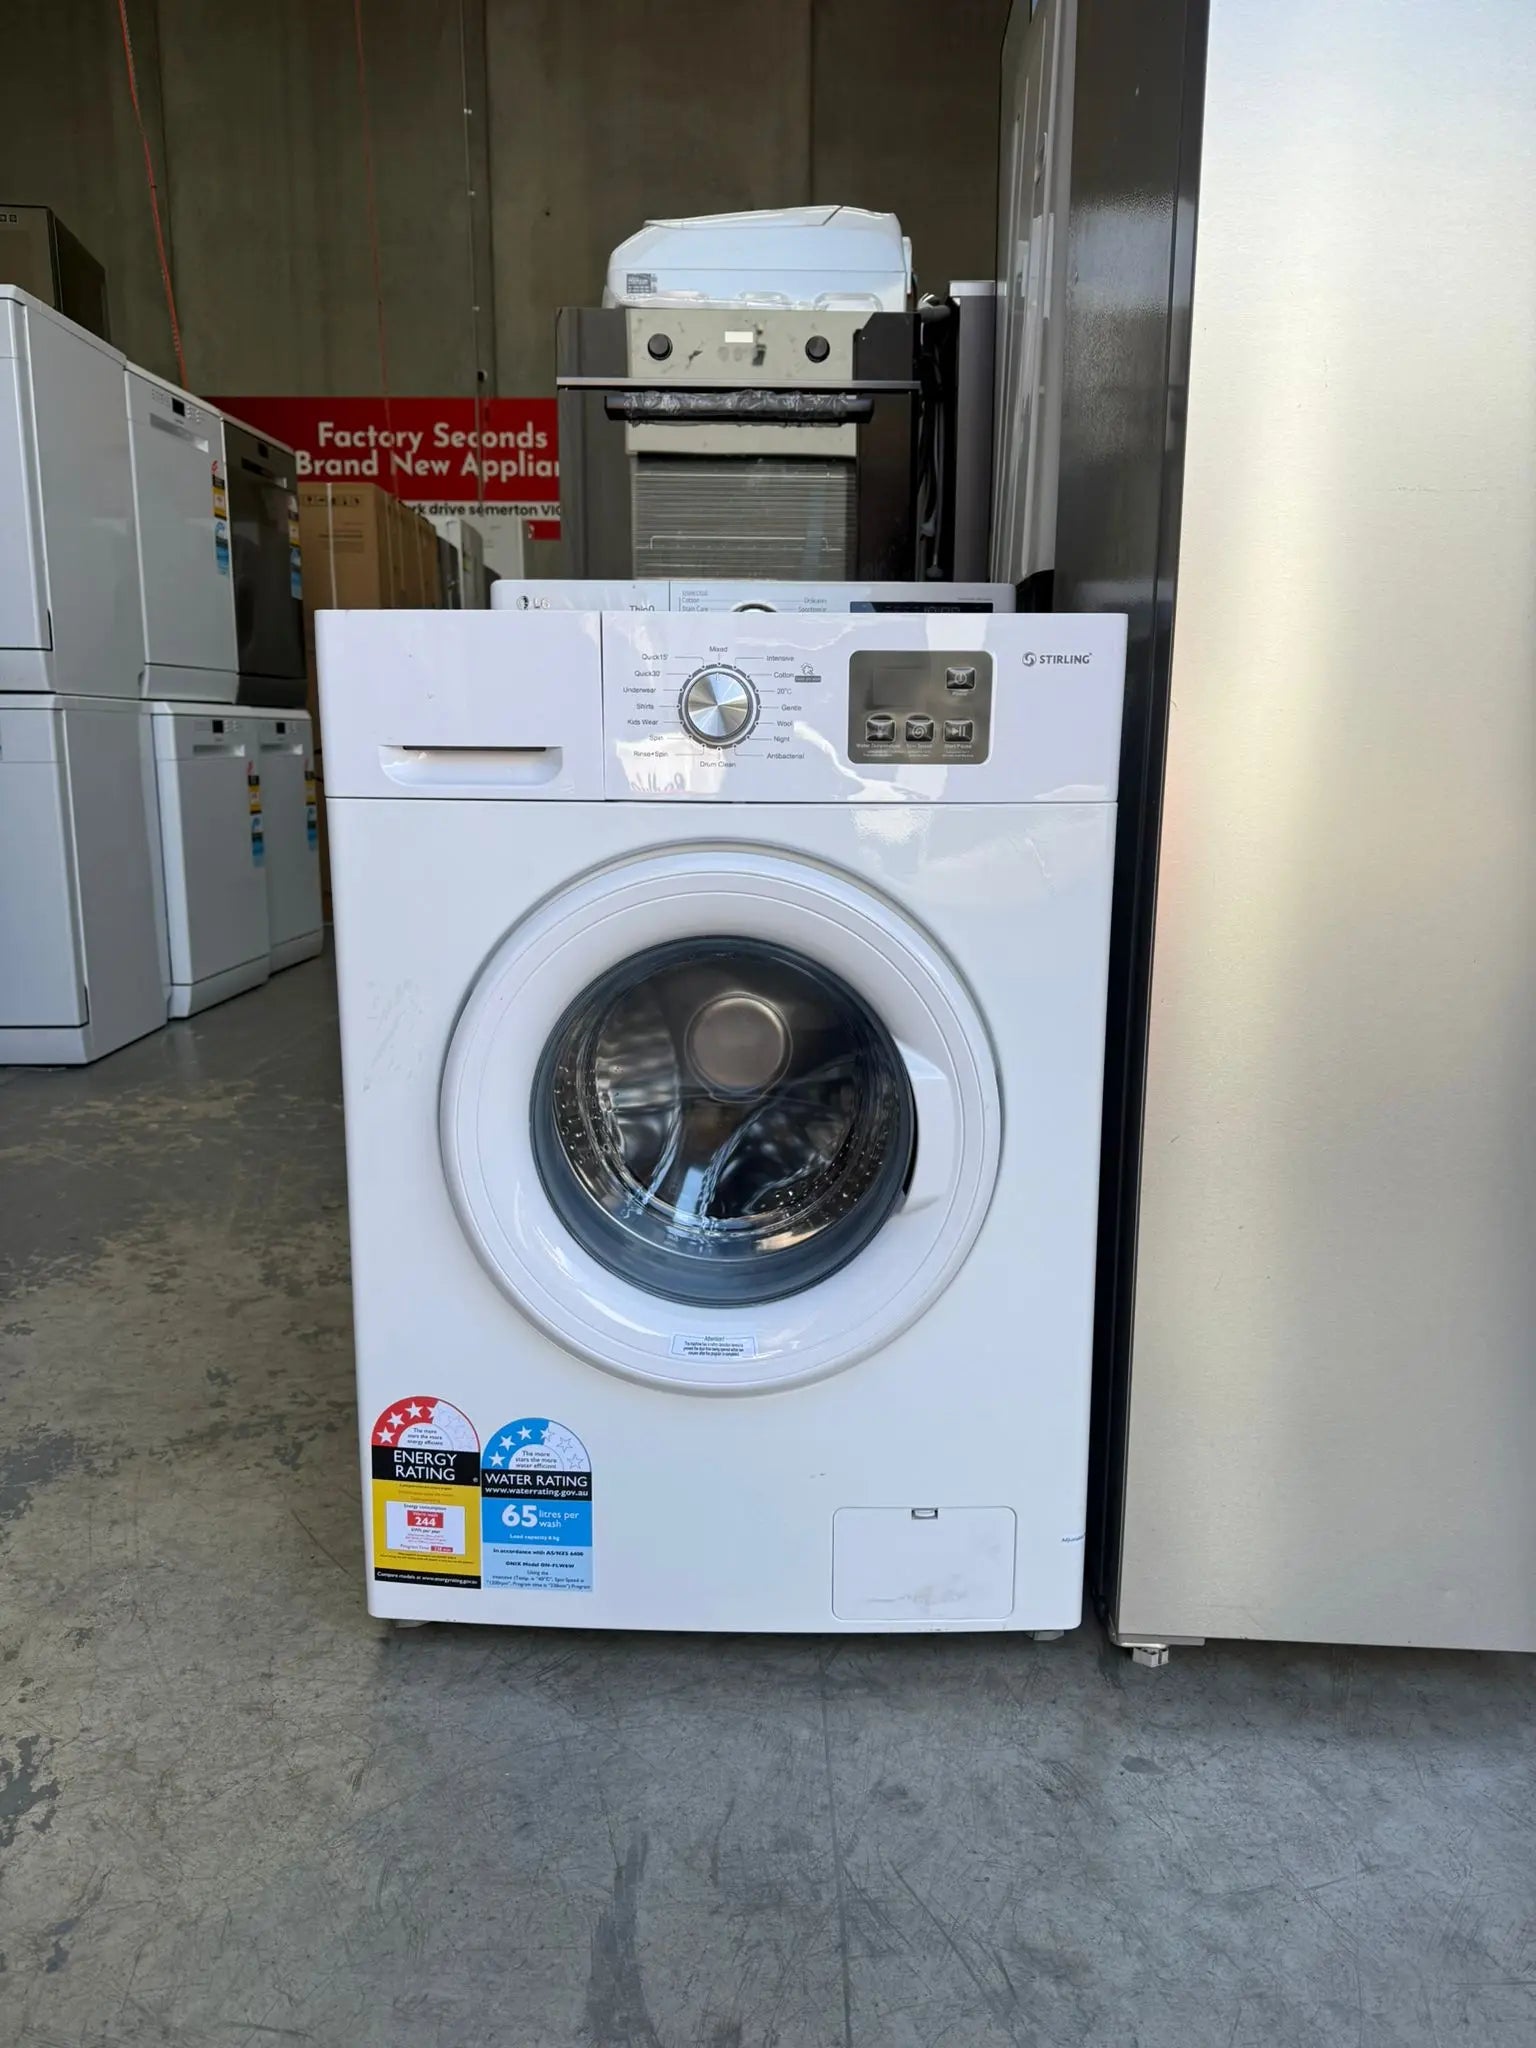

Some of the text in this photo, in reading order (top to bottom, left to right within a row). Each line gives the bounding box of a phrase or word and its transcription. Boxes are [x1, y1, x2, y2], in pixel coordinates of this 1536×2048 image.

[318, 420, 548, 453] Factory Seconds
[295, 449, 378, 476] Brand
[390, 450, 451, 476] New
[429, 503, 466, 516] drive
[533, 598, 551, 609] LG
[1039, 654, 1090, 665] STIRLING
[394, 1450, 457, 1466] ENERGY
[396, 1464, 456, 1481] RATING
[485, 1473, 588, 1487] WATER RATING
[485, 1487, 589, 1497] www.waterrating.gov.au
[501, 1504, 538, 1528] 65
[539, 1509, 580, 1521] litres per
[414, 1516, 436, 1527] 244
[539, 1519, 562, 1528] wash
[376, 1571, 399, 1579] Compare
